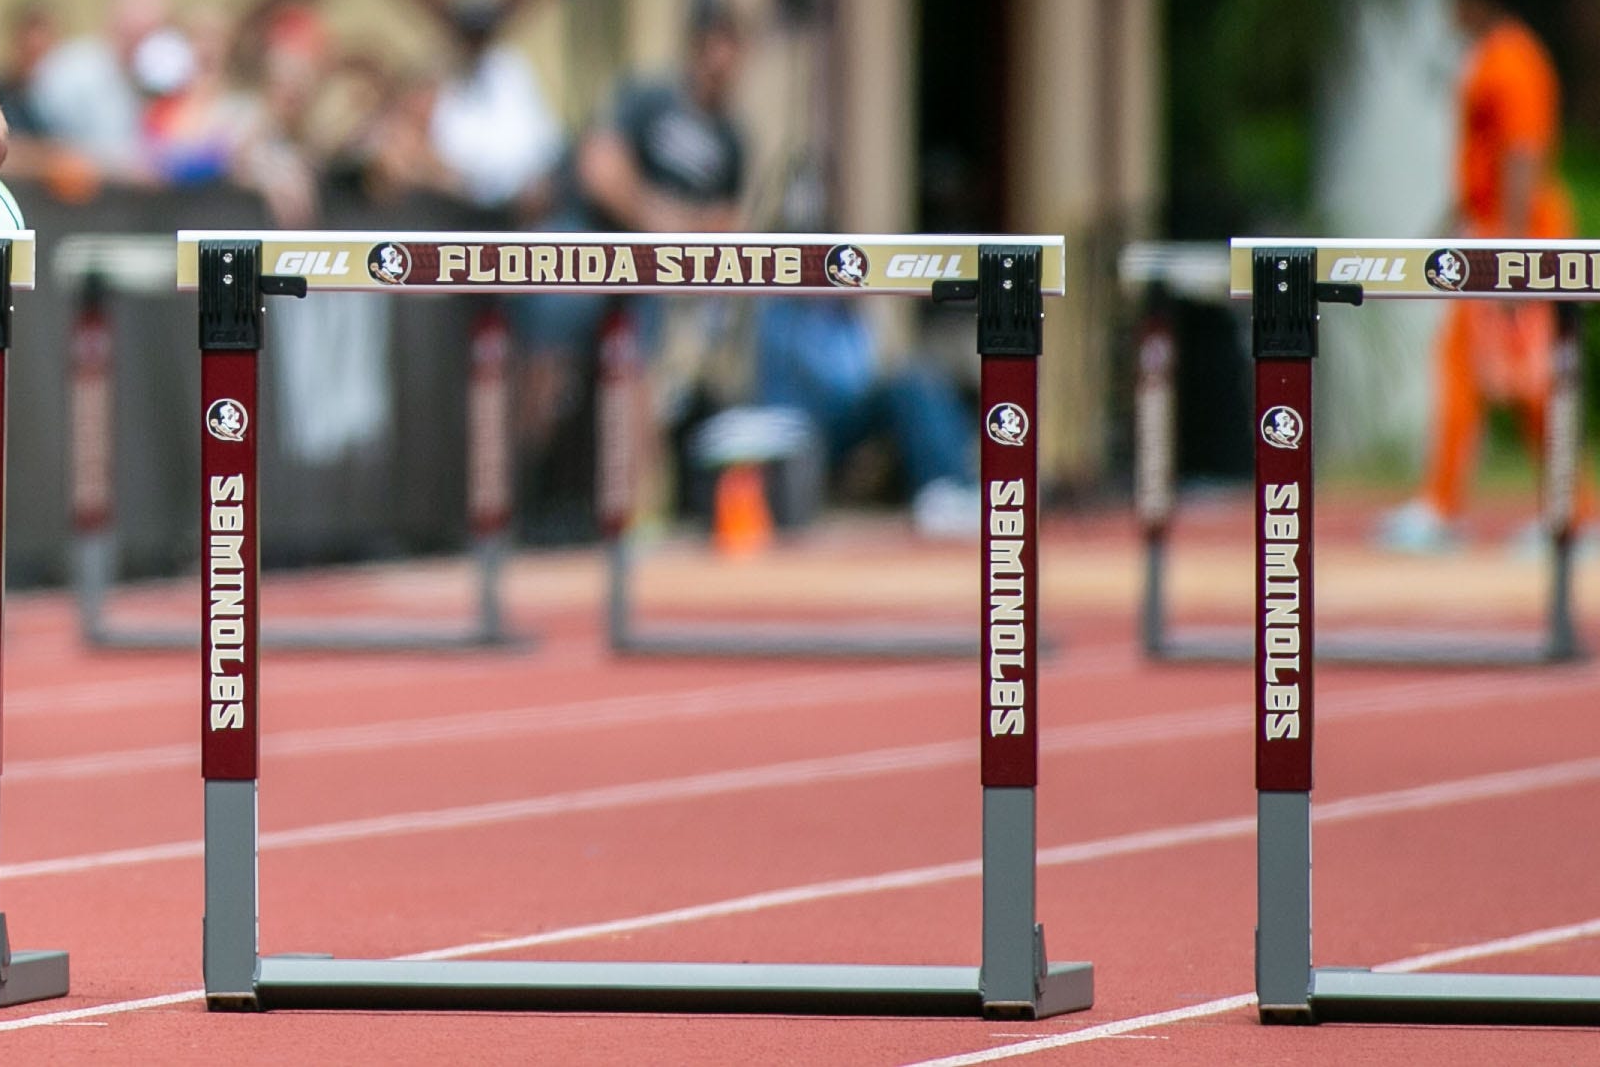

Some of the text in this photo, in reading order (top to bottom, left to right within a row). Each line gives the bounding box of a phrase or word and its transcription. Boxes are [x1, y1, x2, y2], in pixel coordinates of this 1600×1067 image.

[274, 251, 350, 275] GILL
[436, 244, 802, 285] FLORIDA STATE
[885, 254, 962, 278] GILL
[1330, 257, 1407, 281] GILL
[209, 473, 245, 732] SEMINOLES
[989, 478, 1026, 738] SEMINOLES
[1264, 481, 1301, 742] SEMINOLES
